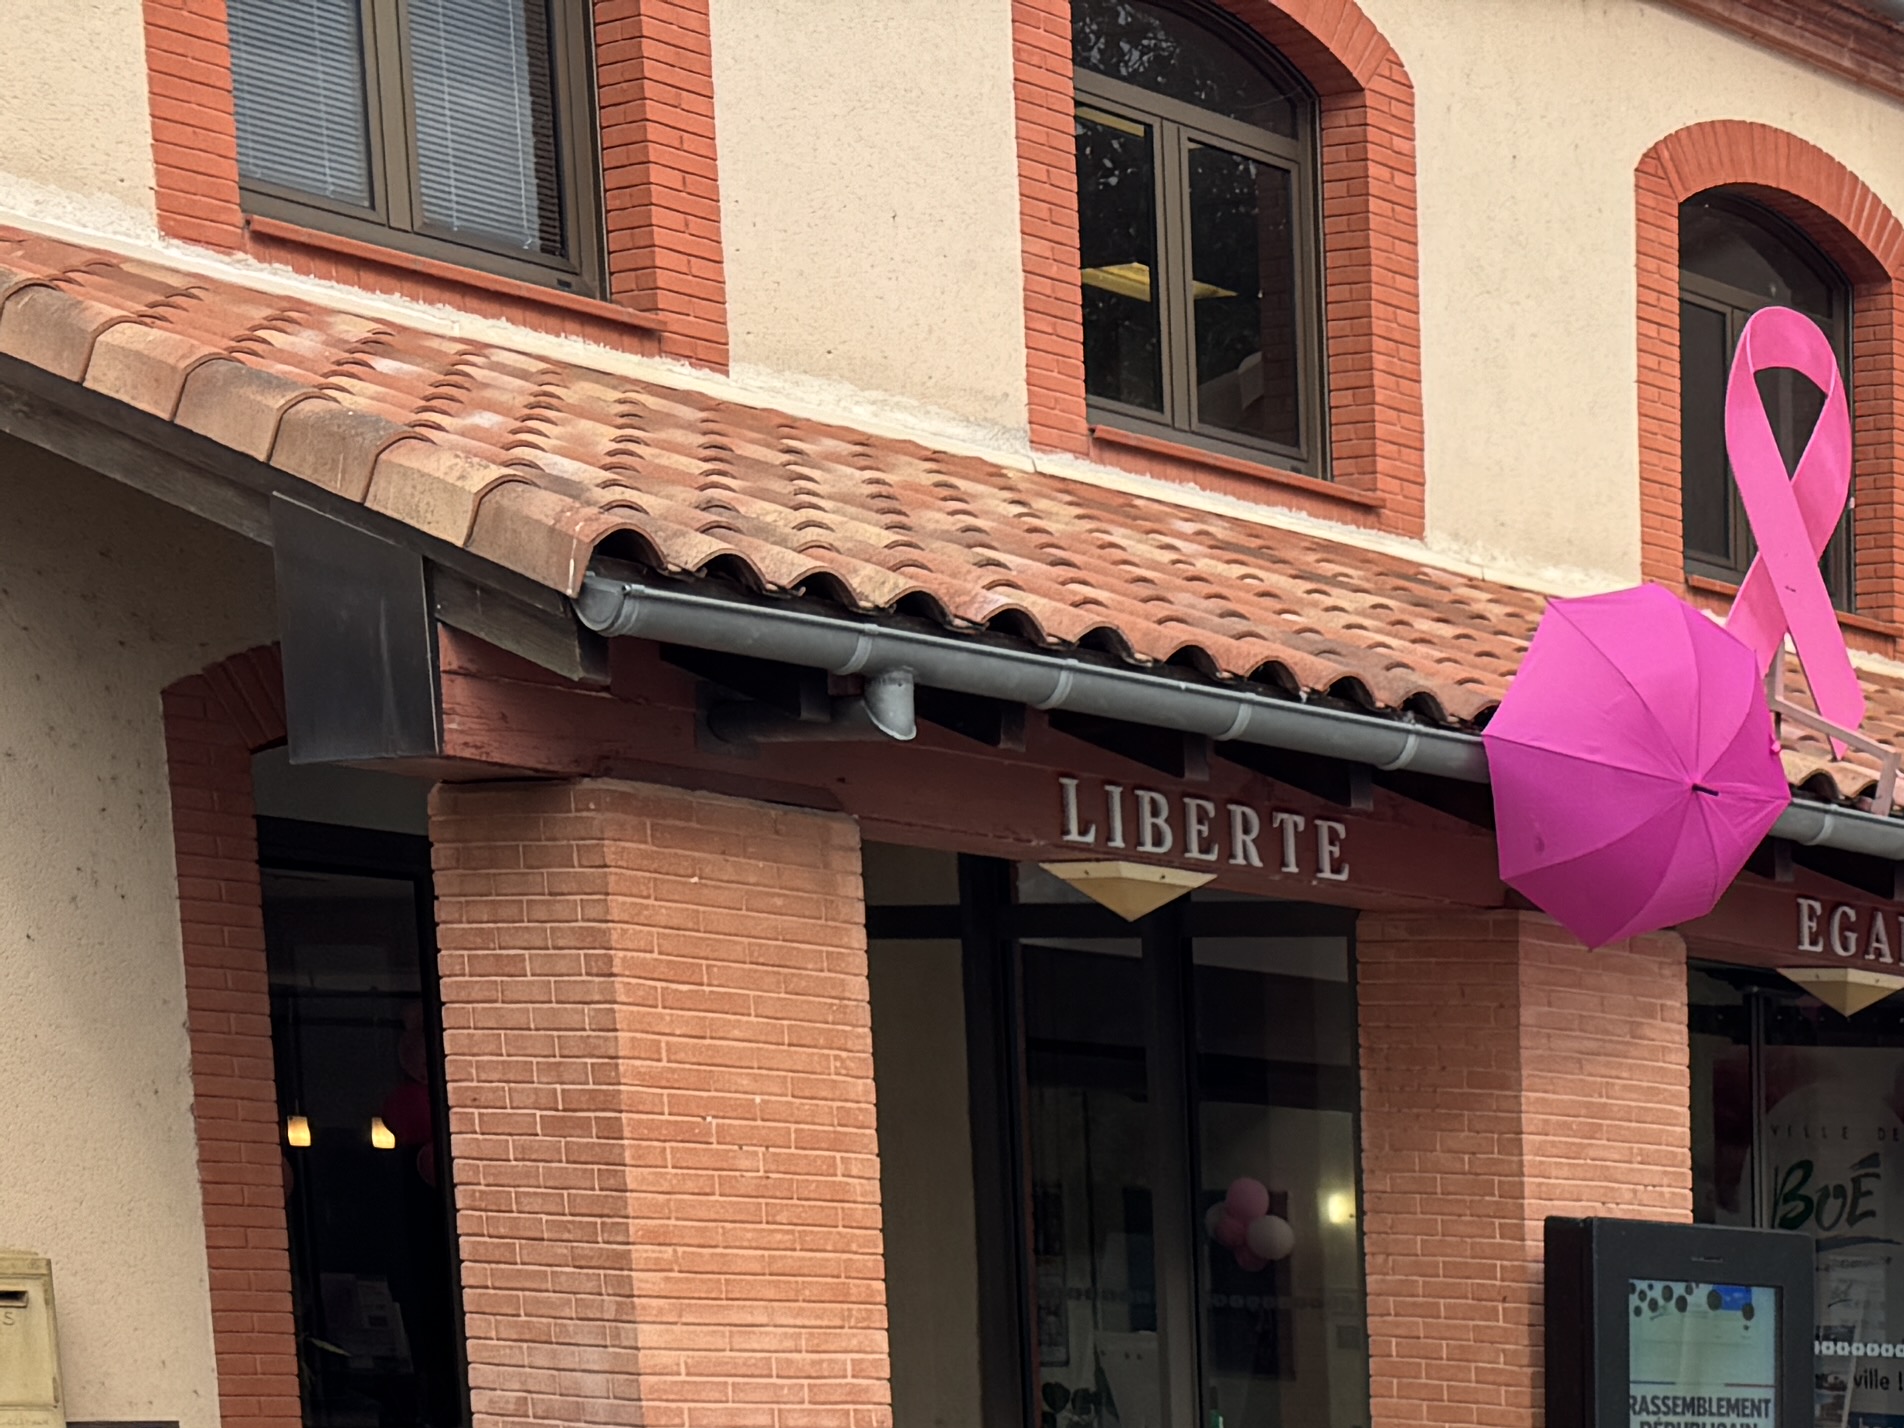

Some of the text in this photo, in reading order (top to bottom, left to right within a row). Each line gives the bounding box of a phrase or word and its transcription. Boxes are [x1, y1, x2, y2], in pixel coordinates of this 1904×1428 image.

[1058, 776, 1350, 882] LIBERTE
[1770, 1125, 1899, 1142] VILLE DE
[1853, 1368, 1890, 1391] ville
[1629, 1394, 1772, 1419] RASSEMBLEMENT
